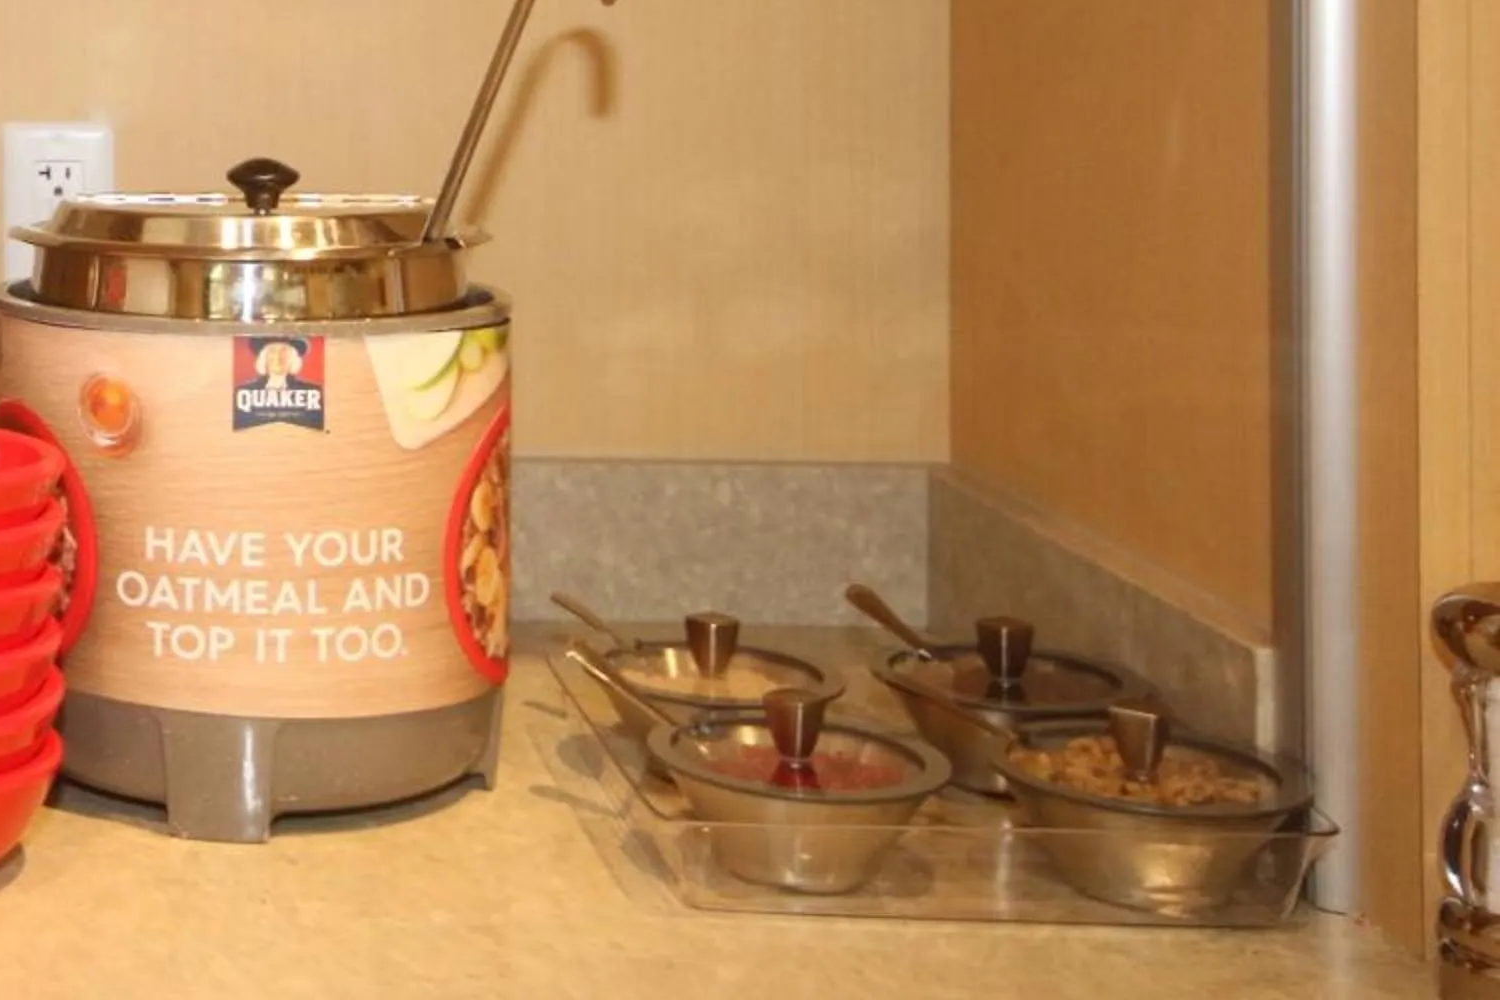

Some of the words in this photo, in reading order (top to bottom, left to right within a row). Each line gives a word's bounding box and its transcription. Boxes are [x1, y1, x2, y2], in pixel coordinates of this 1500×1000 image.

[237, 389, 321, 412] QUAKER
[145, 526, 266, 567] HAVE
[285, 528, 404, 567] YOUR
[116, 570, 328, 616] OATMEAL
[342, 572, 430, 612] AND
[147, 621, 235, 661] TOP
[256, 628, 292, 663] IT
[312, 623, 408, 662] TOO.
